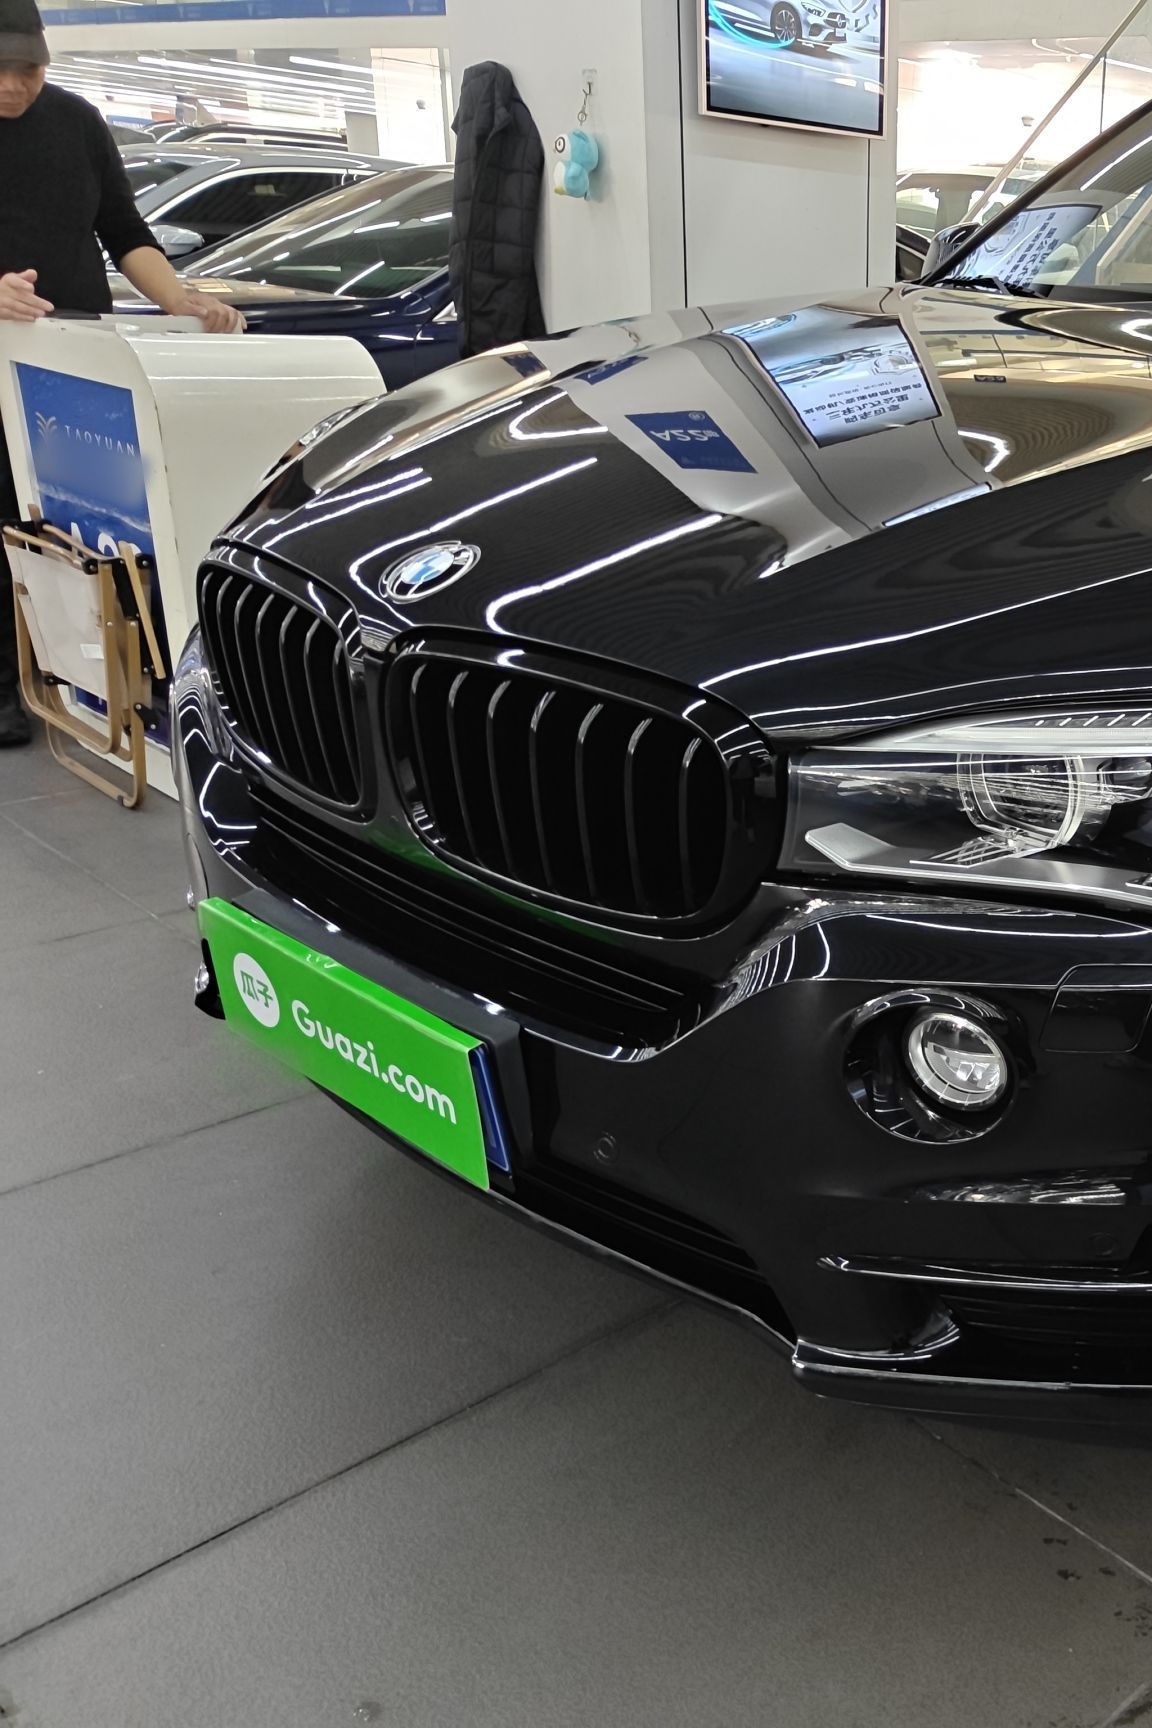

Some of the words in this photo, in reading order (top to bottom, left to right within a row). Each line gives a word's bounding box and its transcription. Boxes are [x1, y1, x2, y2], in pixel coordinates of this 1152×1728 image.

[65, 424, 135, 457] TAOYUAN
[240, 969, 273, 1008] 瓜子
[291, 1000, 457, 1124] Guazi.com
